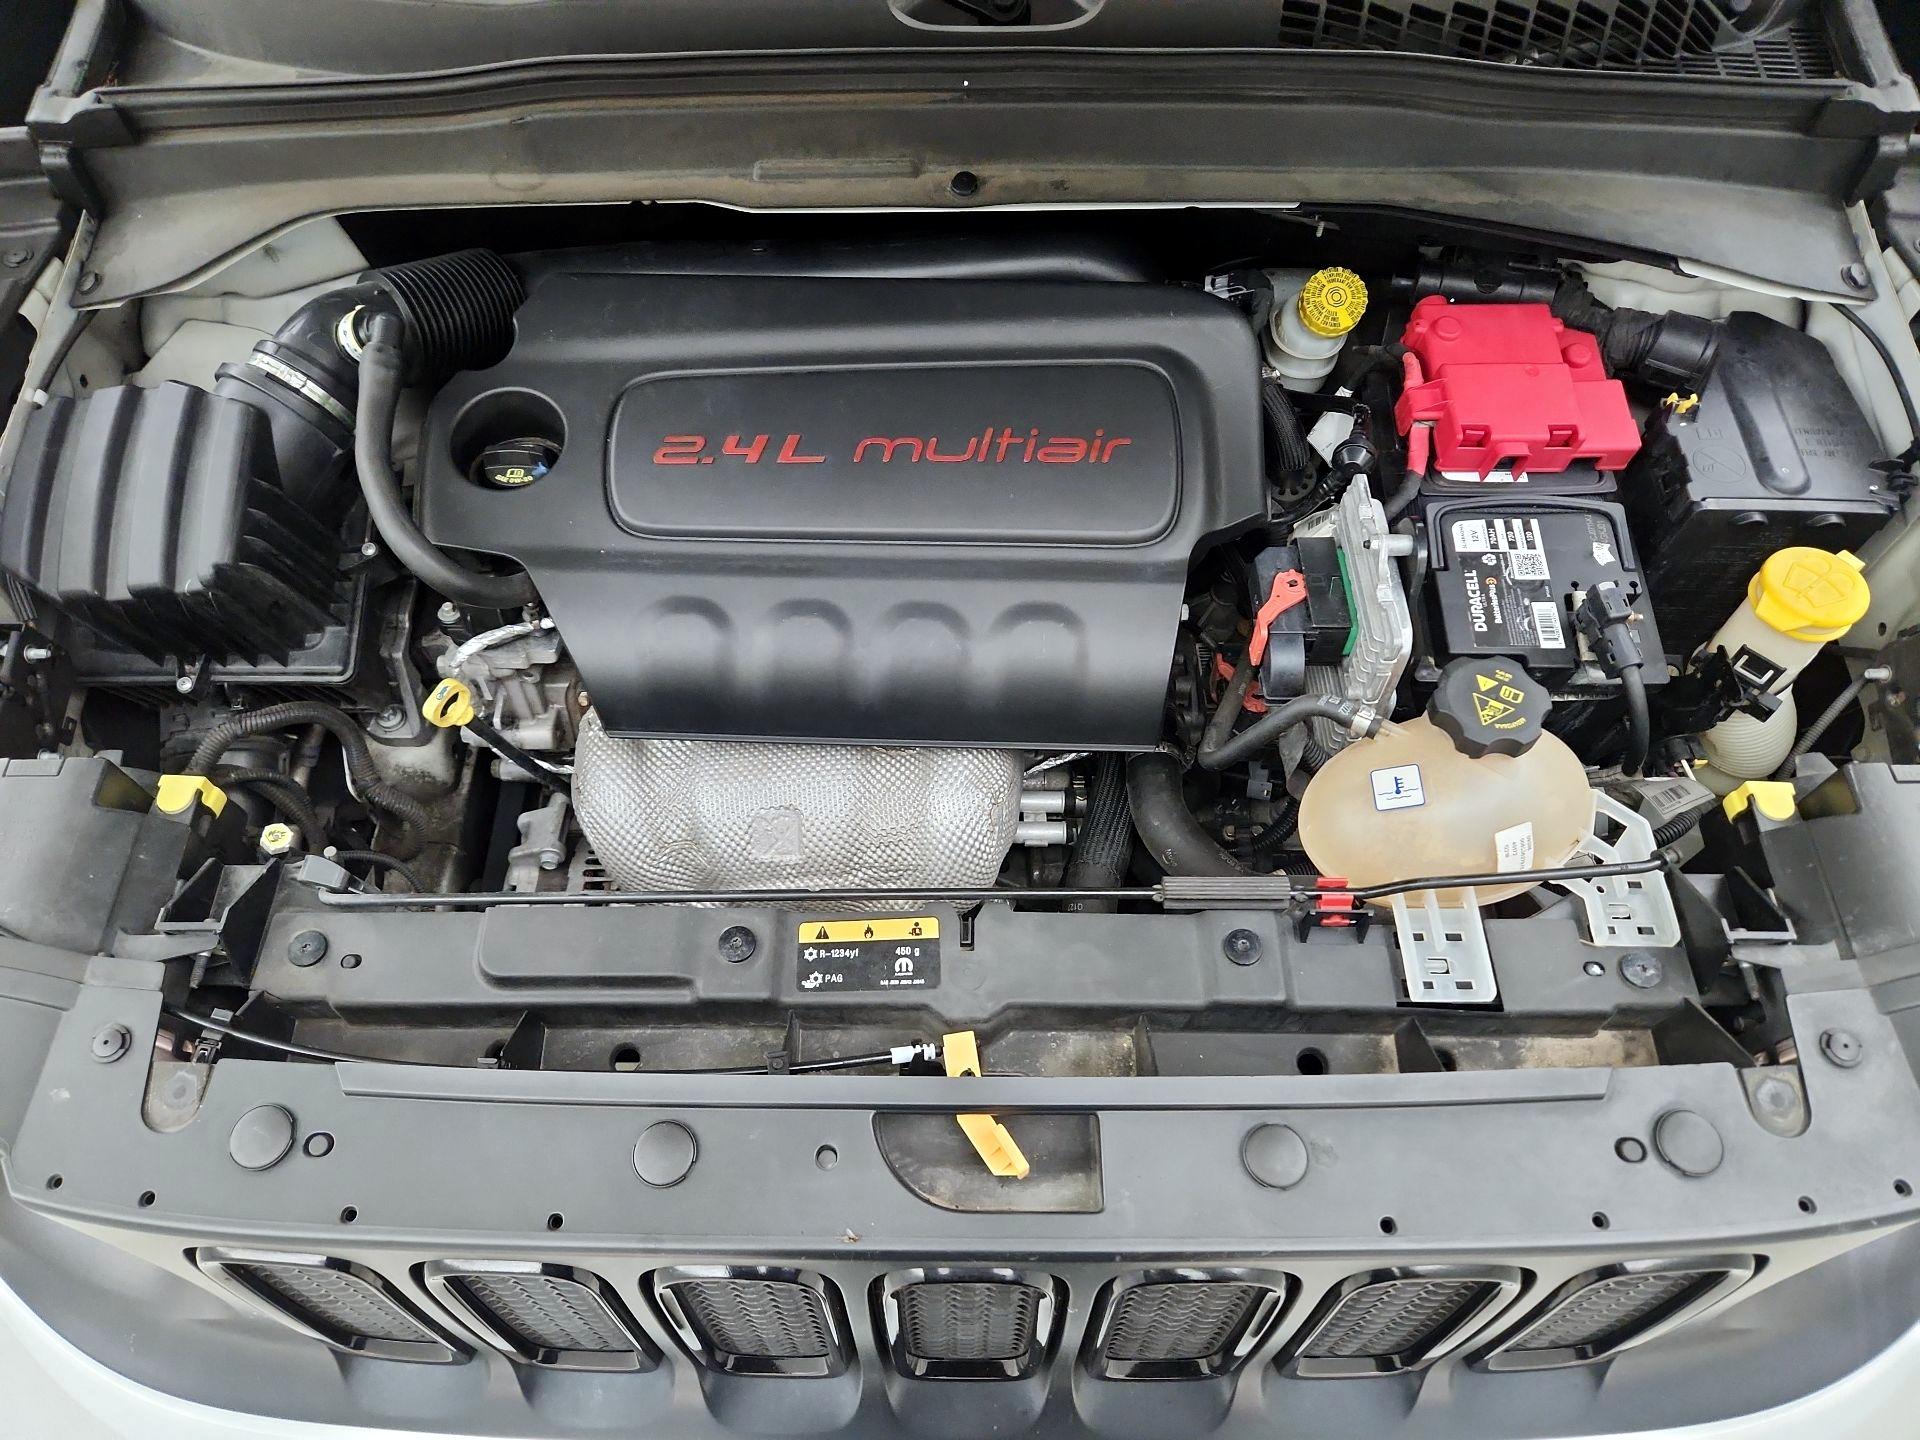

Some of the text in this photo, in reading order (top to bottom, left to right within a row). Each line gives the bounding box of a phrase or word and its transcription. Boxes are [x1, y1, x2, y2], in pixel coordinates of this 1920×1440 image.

[853, 427, 1132, 463] multiair
[1470, 529, 1479, 543] 12V
[1465, 569, 1487, 632] DURACELL
[819, 946, 920, 959] R-1234yf 450 g
[825, 973, 844, 983] PAG
